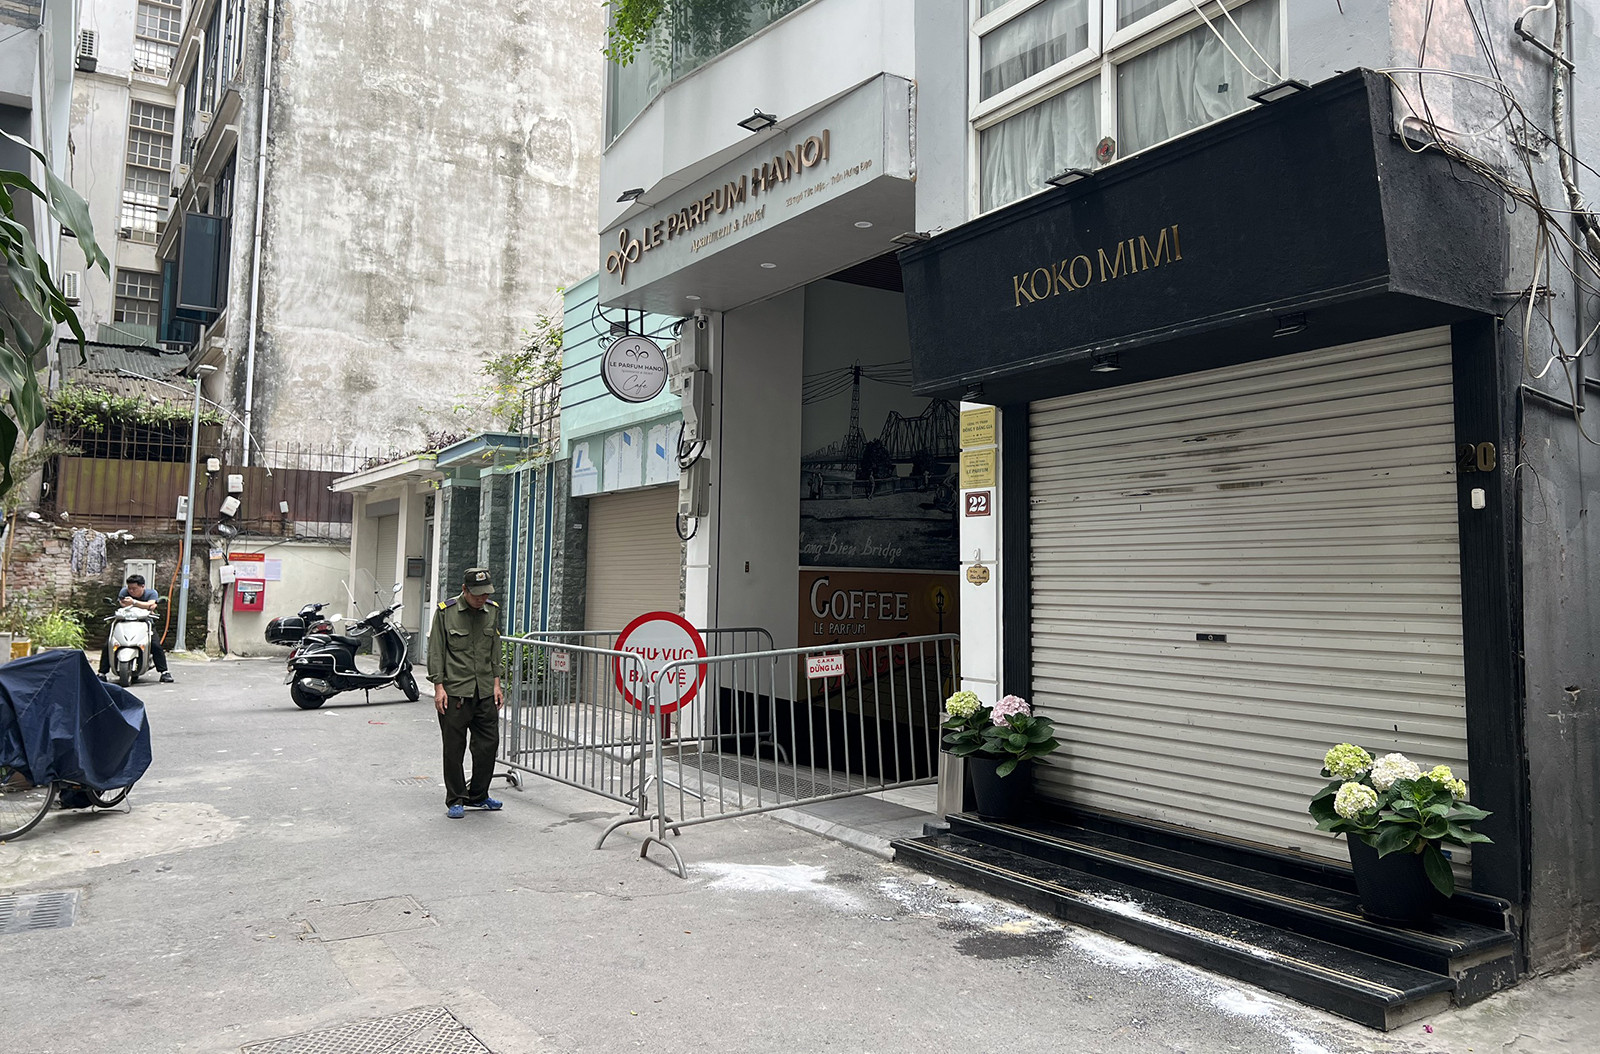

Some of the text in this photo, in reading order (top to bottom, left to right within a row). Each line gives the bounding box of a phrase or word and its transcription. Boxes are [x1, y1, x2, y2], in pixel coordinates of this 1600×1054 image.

[643, 129, 831, 252] LE PARFUM HANOI
[690, 204, 766, 253] Apartment & Hotel
[1012, 223, 1183, 307] KOKO MIMI
[623, 375, 647, 394] Cafe
[1458, 441, 1496, 472] 20
[969, 495, 987, 512] 22
[860, 535, 904, 563] Bridge
[813, 622, 867, 635] LE PARFUM
